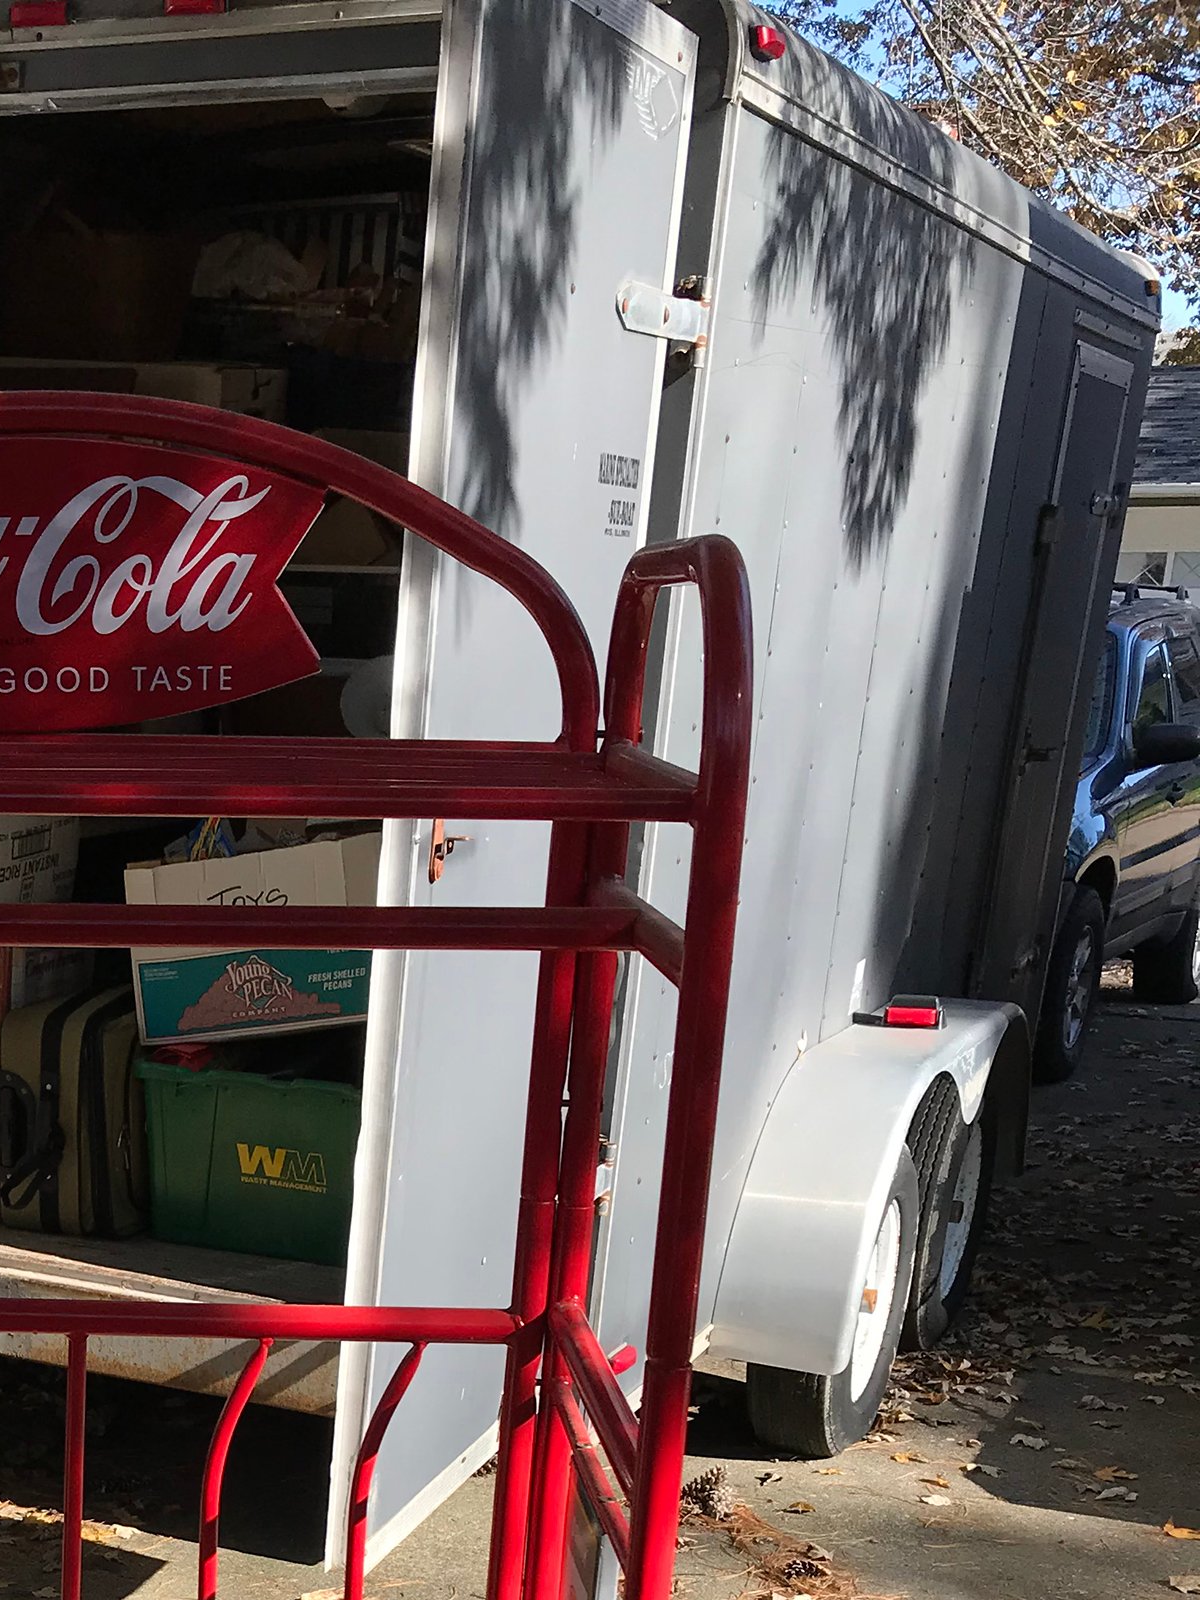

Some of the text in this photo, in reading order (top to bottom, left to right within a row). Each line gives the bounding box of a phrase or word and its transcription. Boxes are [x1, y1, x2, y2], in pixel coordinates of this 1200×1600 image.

[131, 664, 234, 692] TASTE
[225, 961, 273, 993] Young
[307, 967, 366, 983] FRESH SHELLED
[323, 980, 352, 991] PECANS
[242, 979, 293, 1007] PECAN
[236, 1143, 327, 1185] WM
[241, 1176, 327, 1193] WASTE MANAGEMENT
